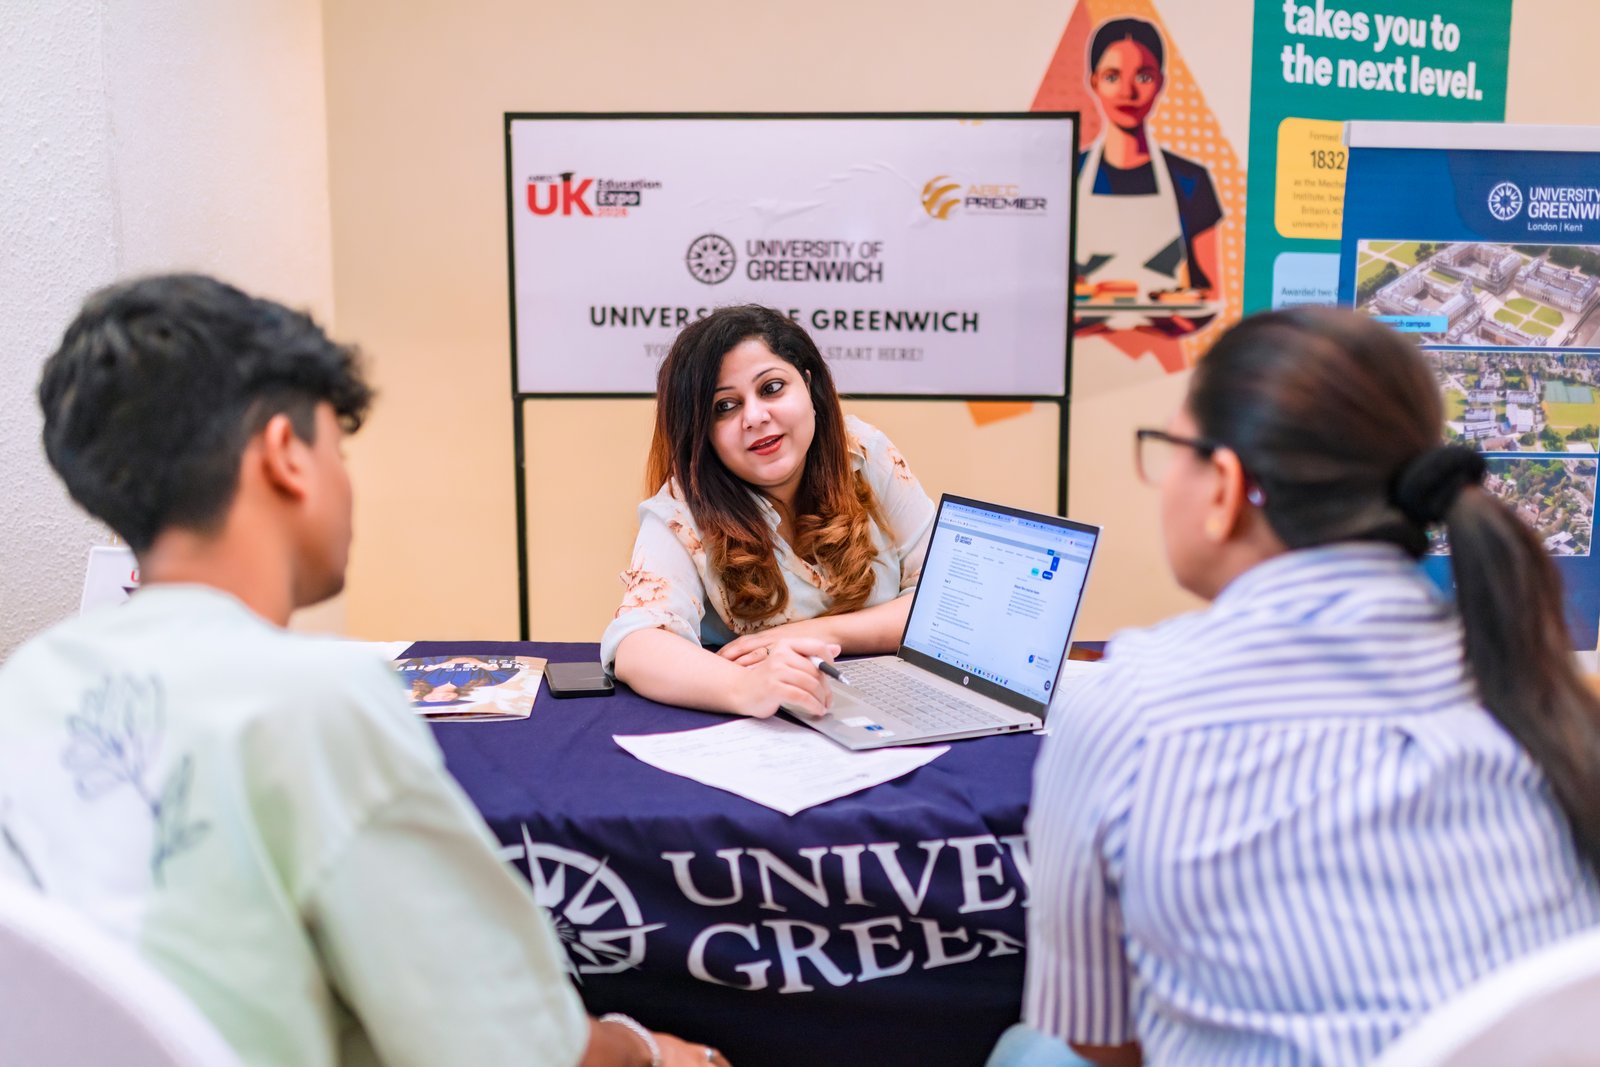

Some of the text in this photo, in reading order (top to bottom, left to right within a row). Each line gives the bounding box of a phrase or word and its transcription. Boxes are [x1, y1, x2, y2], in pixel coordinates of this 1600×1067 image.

[1282, 0, 1461, 53] takes you to
[1280, 43, 1483, 101] the next level.
[1310, 149, 1345, 170] 1832
[598, 179, 662, 191] Education
[527, 178, 595, 217] UK
[964, 197, 1048, 210] PREMIER
[1527, 201, 1600, 220] GREENWI
[1527, 222, 1583, 232] London Kent
[746, 240, 883, 259] UNIVERSITY OF
[746, 260, 883, 283] GREENWICH
[590, 306, 708, 328] UNIVERS
[811, 309, 980, 333] GREENWICH
[825, 346, 872, 361] START
[878, 347, 924, 362] HERE!
